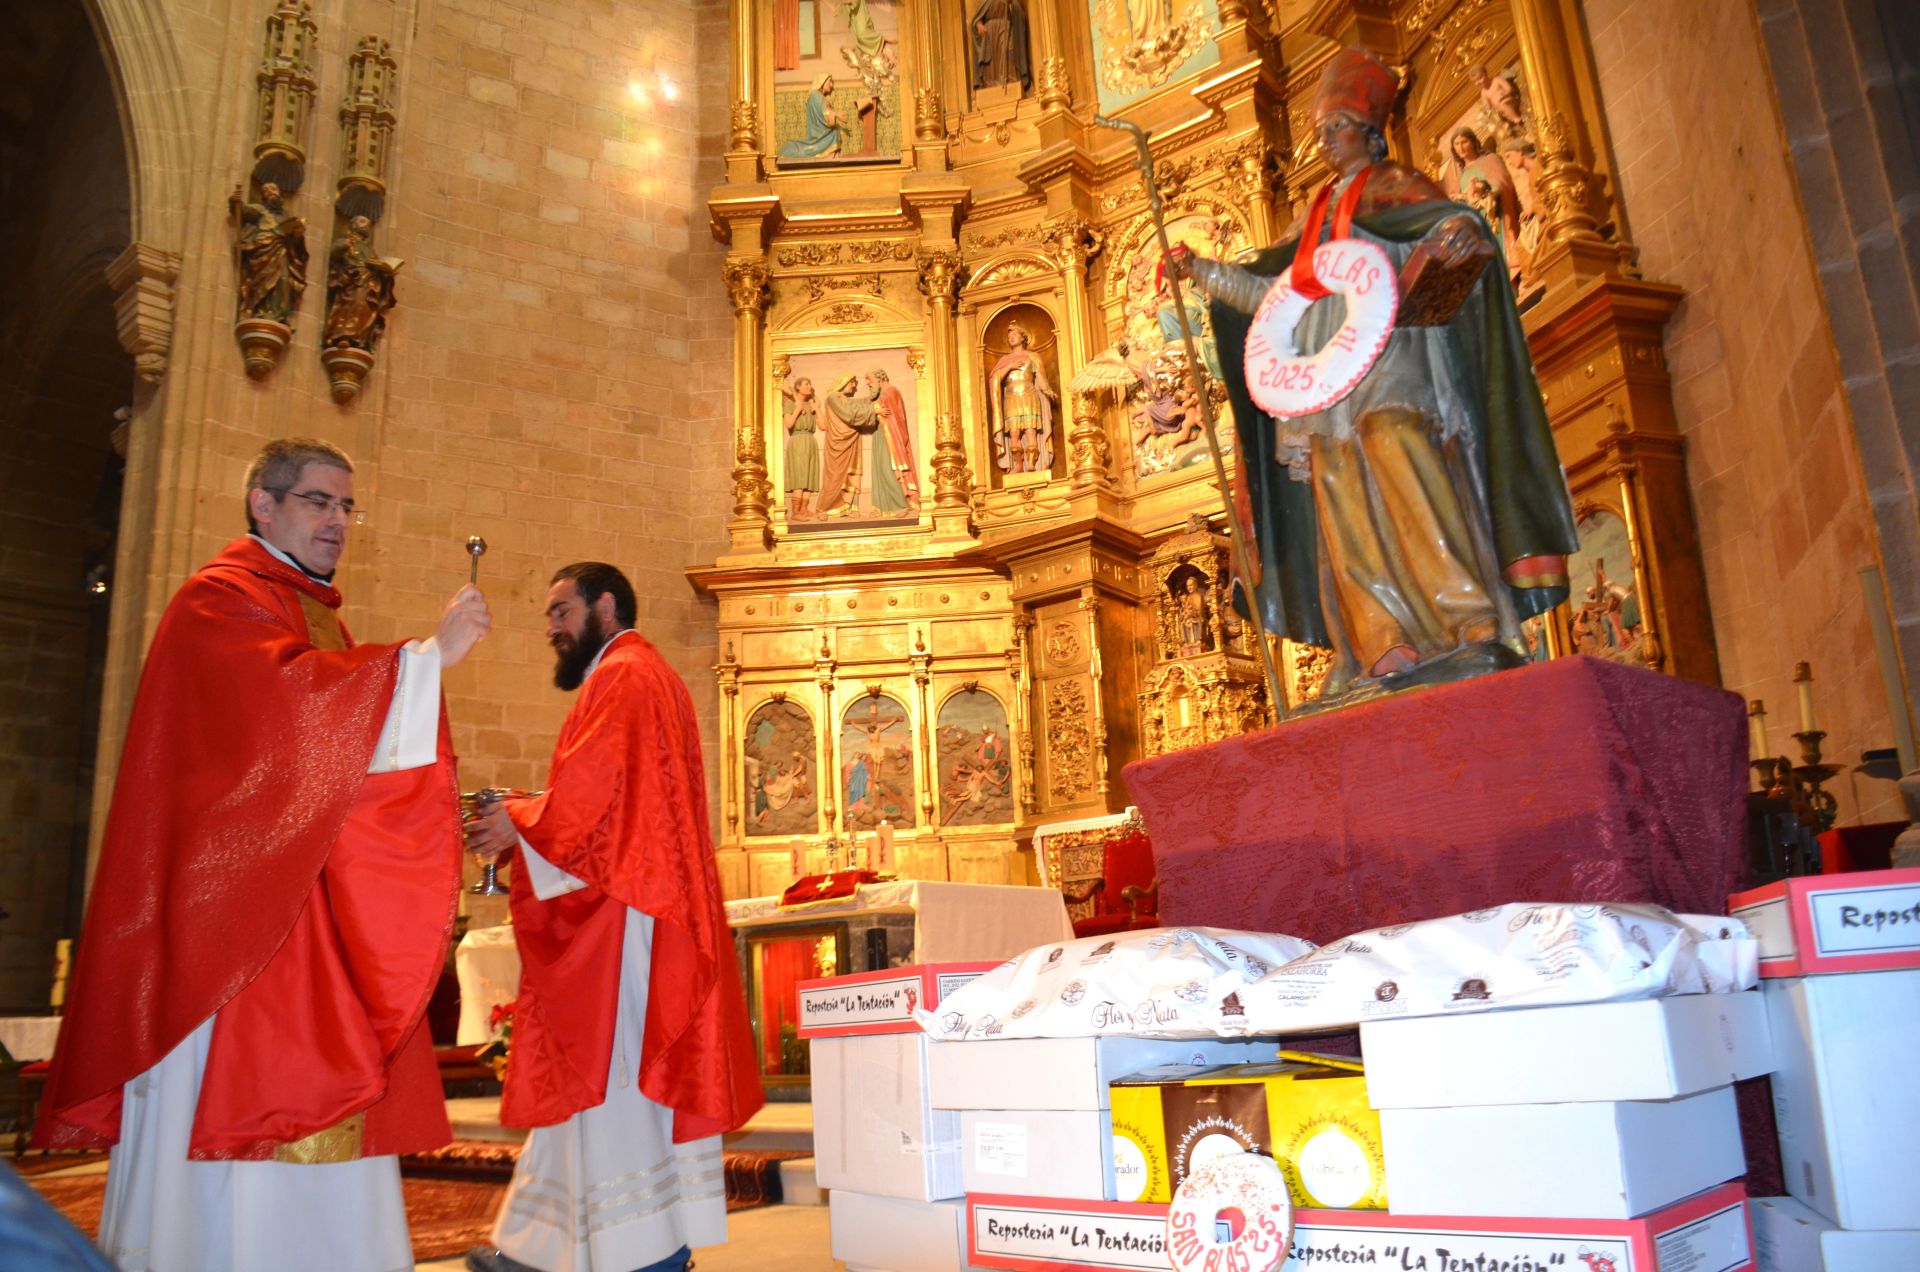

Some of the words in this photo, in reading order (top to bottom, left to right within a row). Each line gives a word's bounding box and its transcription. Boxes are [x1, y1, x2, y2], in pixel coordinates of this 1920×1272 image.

[1313, 250, 1380, 296] BLAS
[1259, 357, 1316, 390] 2025
[1091, 1000, 1125, 1028] Flor
[1133, 999, 1179, 1026] Nata
[1171, 1210, 1204, 1266] SAN
